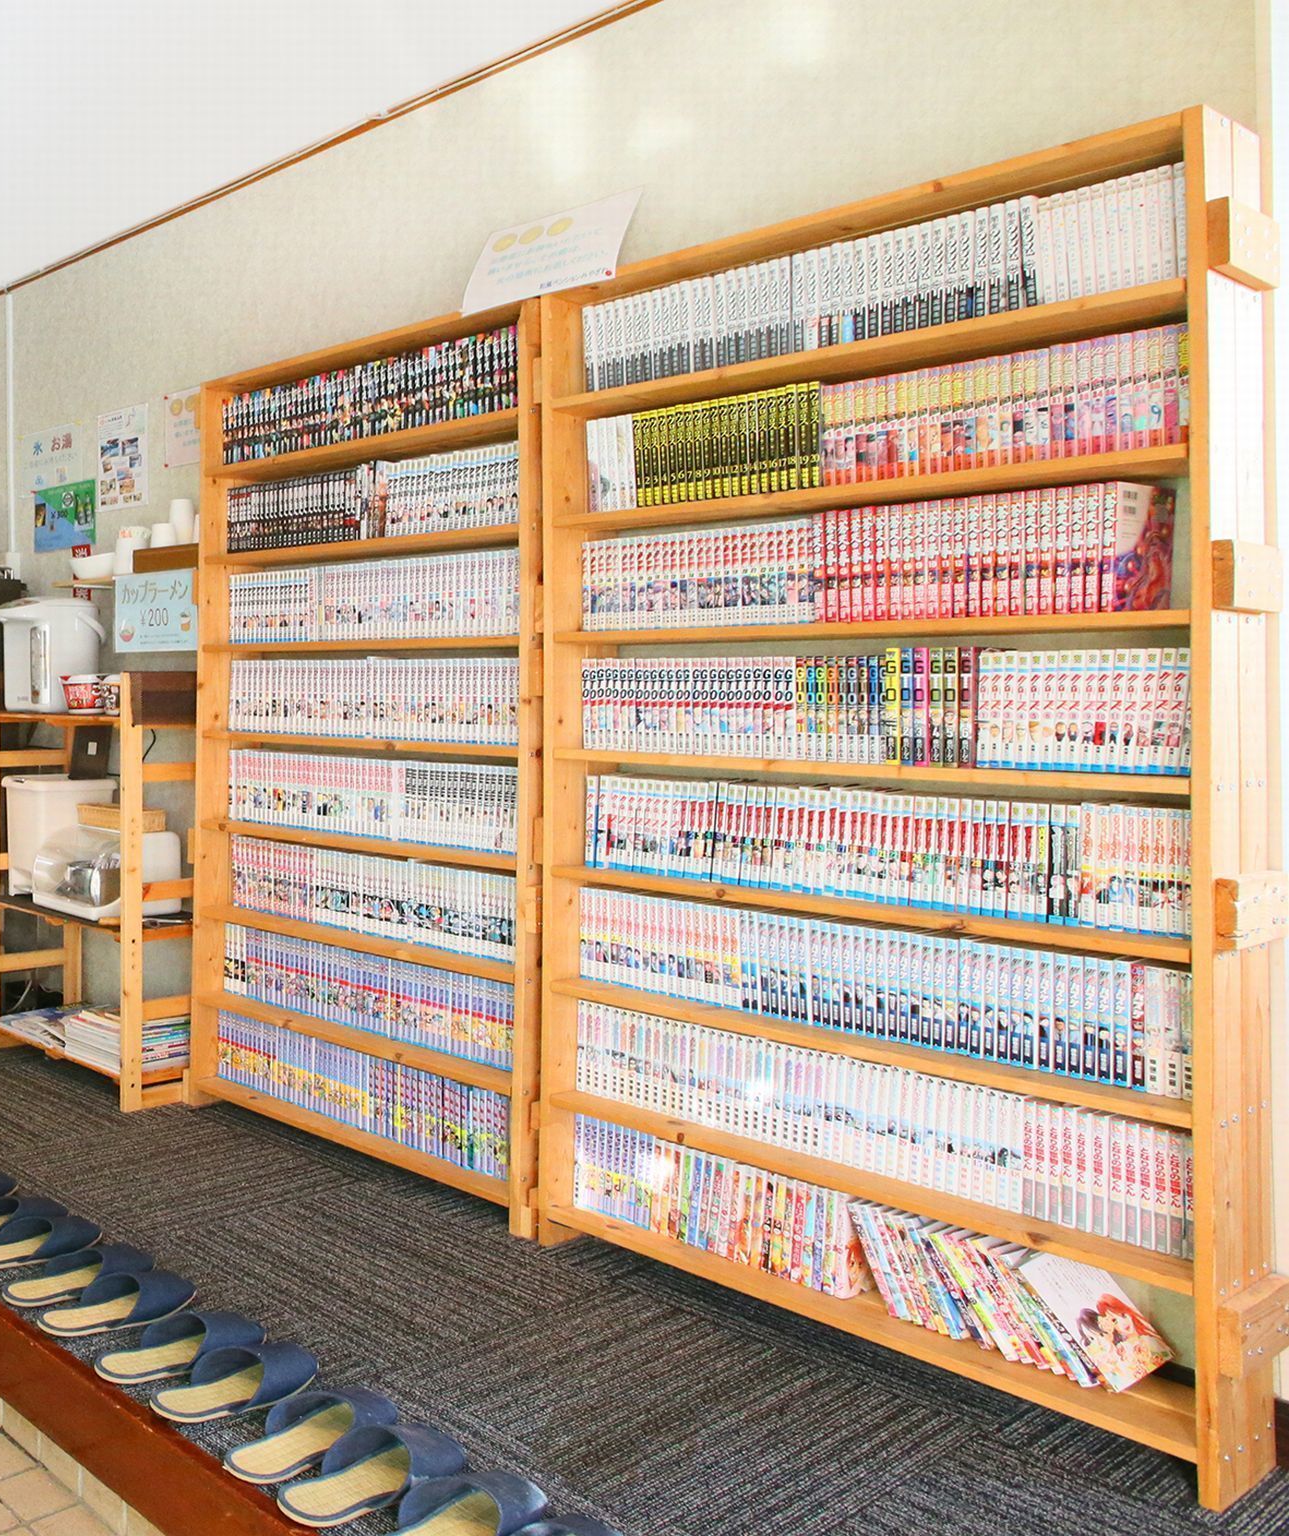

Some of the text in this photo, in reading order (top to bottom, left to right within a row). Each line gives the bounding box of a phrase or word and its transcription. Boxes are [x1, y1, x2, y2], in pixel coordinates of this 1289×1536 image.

[33, 432, 73, 456] 水 お湯
[799, 455, 809, 465] 19
[810, 454, 820, 463] 20
[670, 472, 676, 481] 5
[678, 470, 685, 479] 6
[687, 471, 693, 479] 7
[695, 469, 702, 478] 8
[704, 468, 711, 478] 9
[712, 467, 721, 475] 10
[731, 465, 739, 473] 12
[740, 464, 748, 473] 13
[759, 461, 767, 470] 15
[769, 459, 778, 468] 16
[779, 458, 787, 467] 17
[645, 476, 651, 484] 2
[653, 476, 659, 484] 3
[121, 579, 189, 605] カップラーメン
[140, 608, 169, 628] ¥200
[635, 669, 643, 699] GTO
[650, 669, 658, 700] GTO
[675, 669, 683, 700] GTO
[683, 669, 691, 700] GTO
[701, 669, 709, 700] GTO
[710, 669, 718, 700] GTO
[718, 669, 726, 700] GTO
[727, 669, 735, 701] GTO
[735, 669, 743, 701] GTO
[744, 669, 752, 701] GTO
[753, 669, 762, 701] GTO
[763, 669, 772, 701] GTO
[775, 669, 784, 701] GTO
[784, 669, 794, 701] GTO
[797, 667, 805, 704] GTO
[806, 667, 815, 704] GTO
[816, 667, 825, 704] GTO
[827, 667, 836, 704] GTO
[838, 667, 846, 704] GTO
[848, 667, 857, 704] GTO
[859, 667, 868, 704] GTO
[870, 667, 878, 704] GTO
[886, 660, 896, 702] GTO
[901, 660, 911, 702] GTO
[914, 660, 924, 702] GTO
[931, 660, 941, 702] GTO
[945, 660, 956, 702] GTO
[961, 660, 971, 702] GTO
[980, 674, 989, 710] クローズ
[991, 674, 1001, 710] クローズ
[1004, 674, 1014, 710] クローズ
[1016, 675, 1027, 710] クローズ
[1029, 674, 1041, 711] クローズ
[1044, 674, 1055, 710] クローズ
[1056, 673, 1069, 710] クローズ
[1069, 674, 1082, 710] クローズ
[1083, 674, 1097, 711] クローズ
[1096, 674, 1110, 711] クローズ
[1111, 673, 1125, 711] クローズ
[1125, 674, 1140, 711] クローズ
[1141, 673, 1155, 711] クローズ
[1156, 672, 1172, 710] クローズ
[1172, 672, 1187, 711] クローズ
